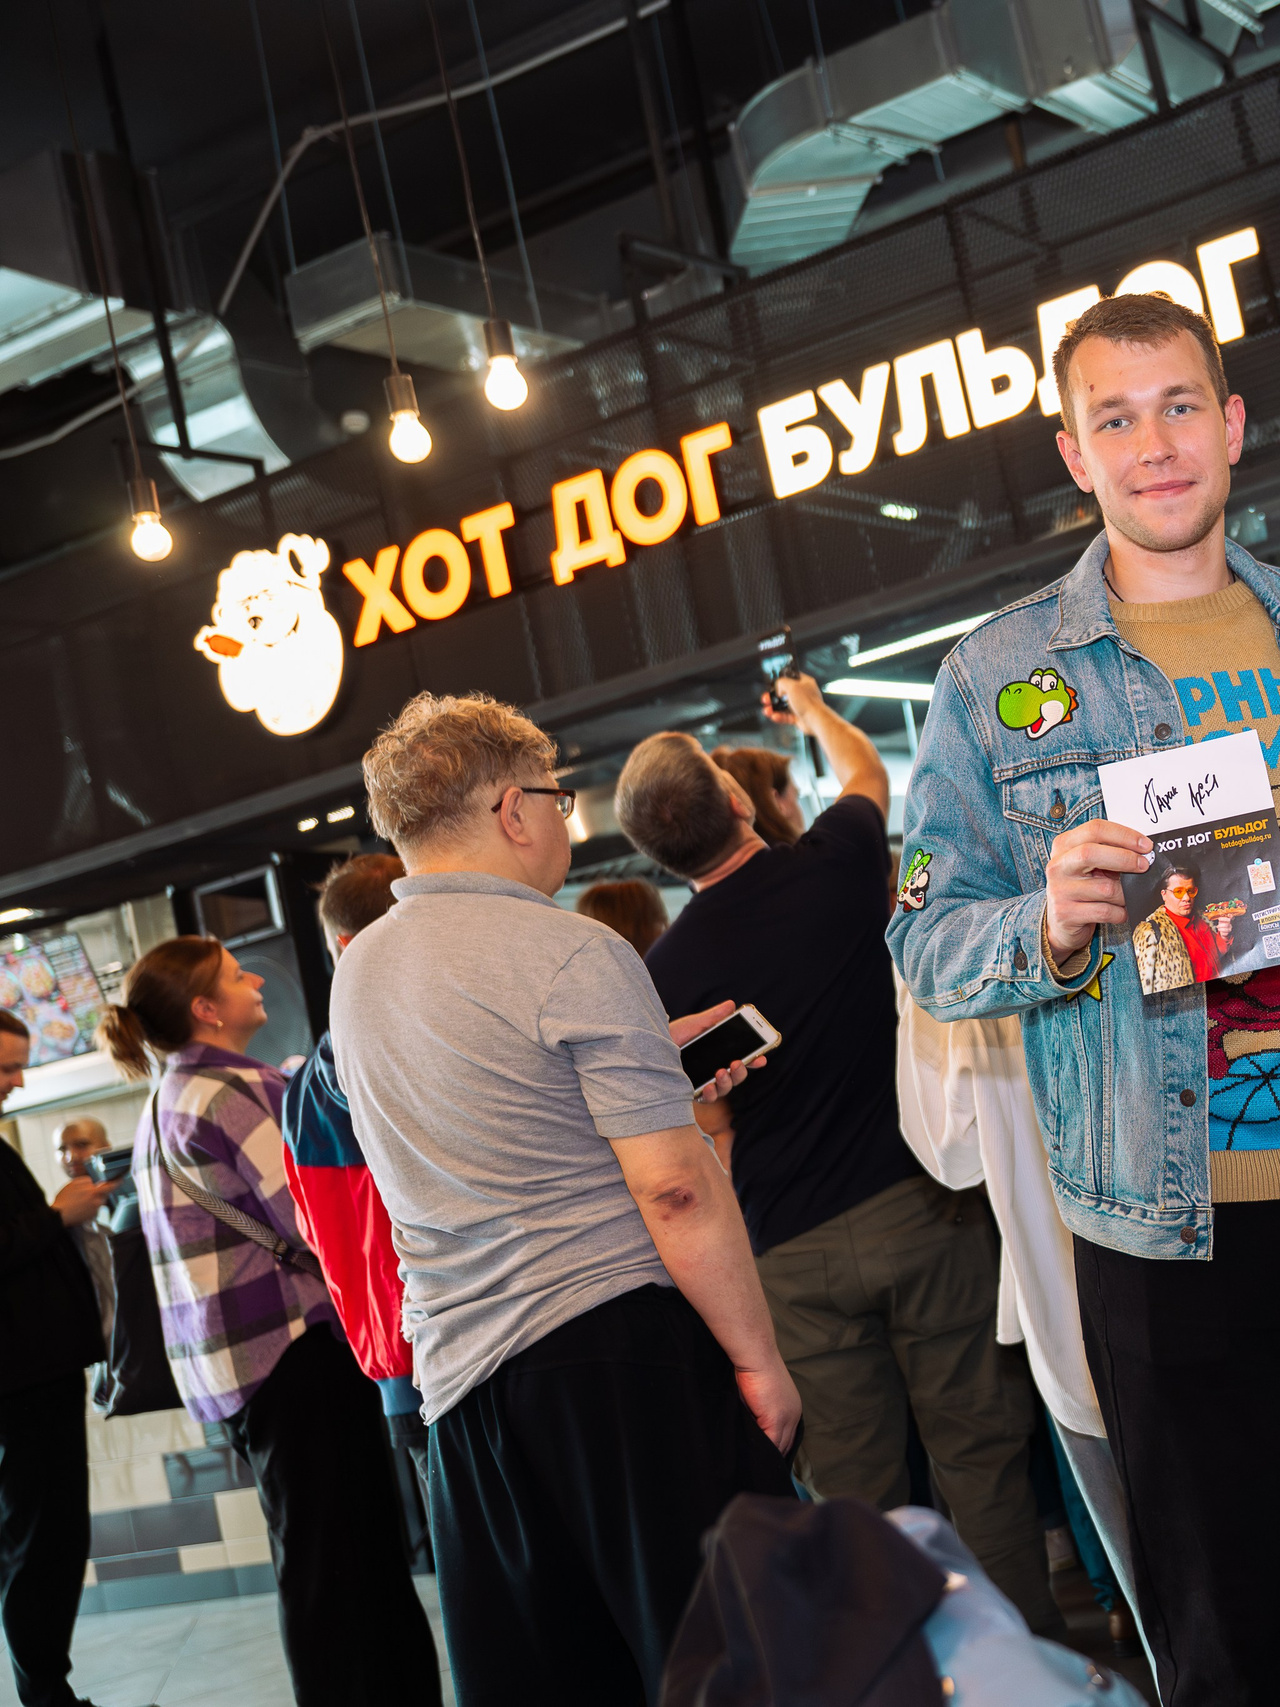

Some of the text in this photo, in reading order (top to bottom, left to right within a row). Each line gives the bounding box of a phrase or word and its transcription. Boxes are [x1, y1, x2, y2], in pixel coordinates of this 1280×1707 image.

[342, 501, 515, 648] ХОТ
[550, 421, 733, 586] ДОГ
[1157, 818, 1269, 853] ХОТ ДОГ БУЛЬДОГ
[1220, 833, 1272, 849] hotdogbulldog.ru
